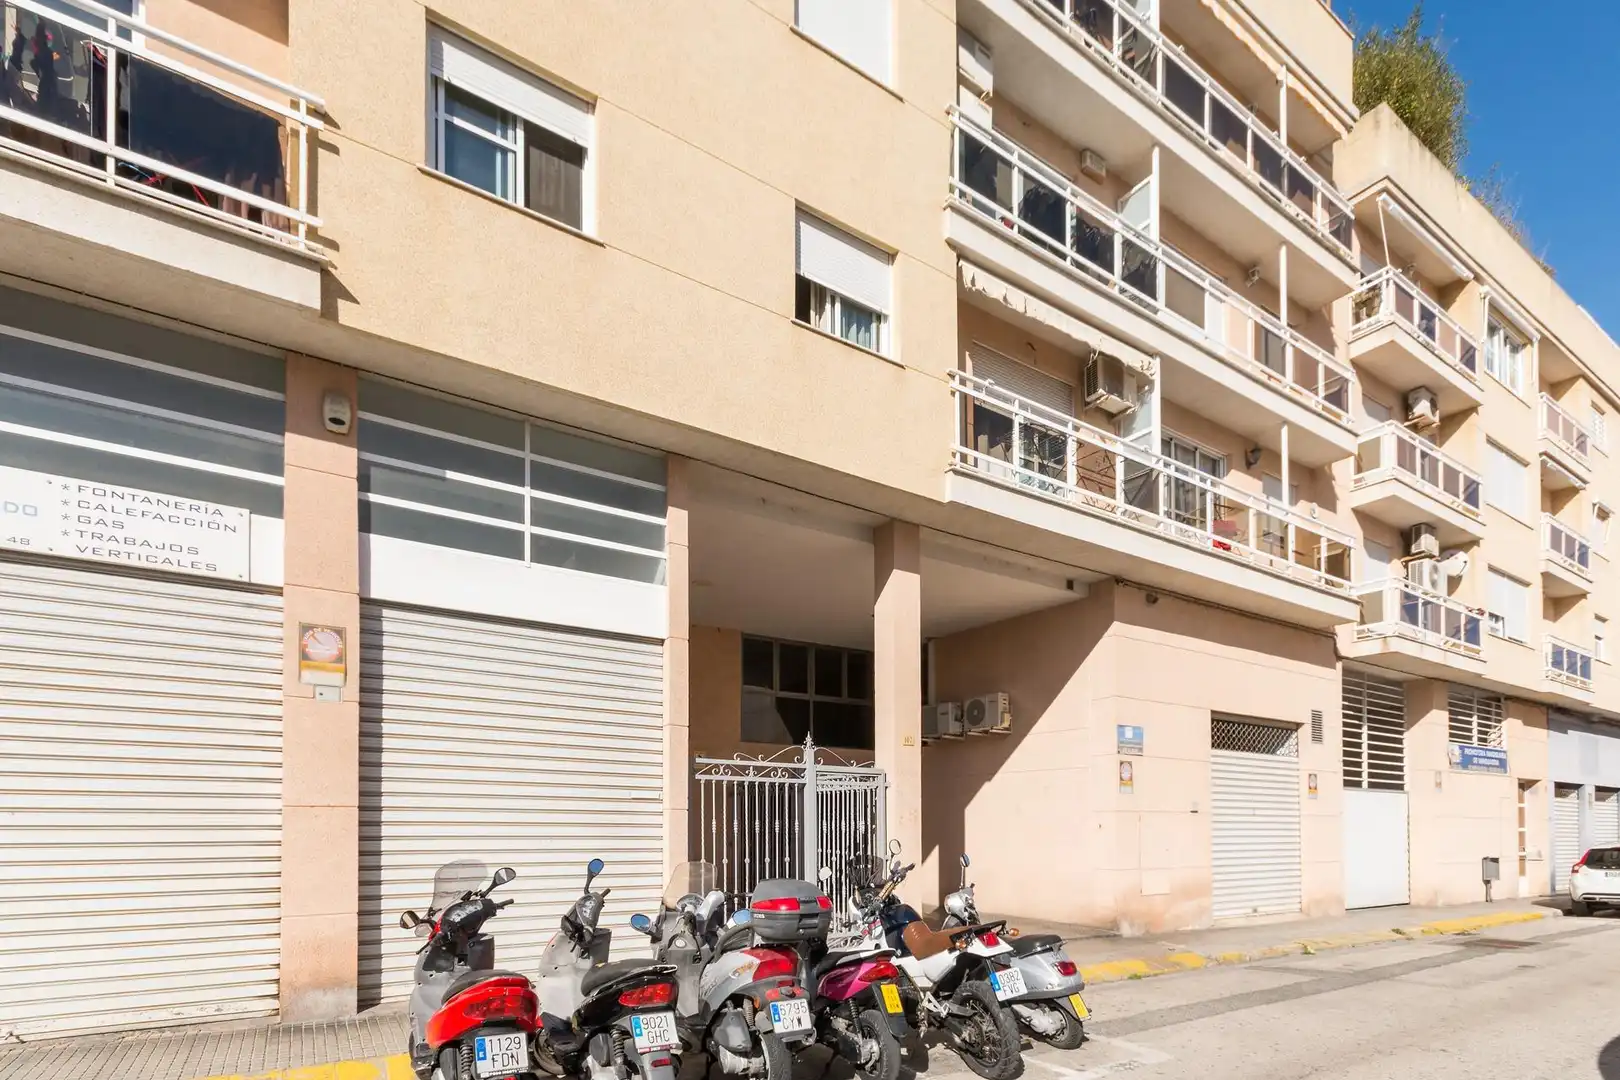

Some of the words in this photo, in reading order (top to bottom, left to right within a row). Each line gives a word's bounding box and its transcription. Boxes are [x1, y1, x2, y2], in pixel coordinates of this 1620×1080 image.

[77, 484, 224, 517] FONTANERÍA
[77, 500, 237, 533] CALEFACCIÓN
[77, 515, 125, 530] GAS
[6, 536, 30, 546] 48
[75, 529, 200, 555] TRABAJOS
[75, 544, 217, 572] VERTICALES
[999, 969, 1021, 985] 0382
[1002, 982, 1020, 997] FVG
[780, 1001, 807, 1017] 6795
[641, 1015, 669, 1030] 9021
[647, 1028, 670, 1044] GHC
[488, 1036, 521, 1053] 1129
[490, 1051, 520, 1069] FDN
